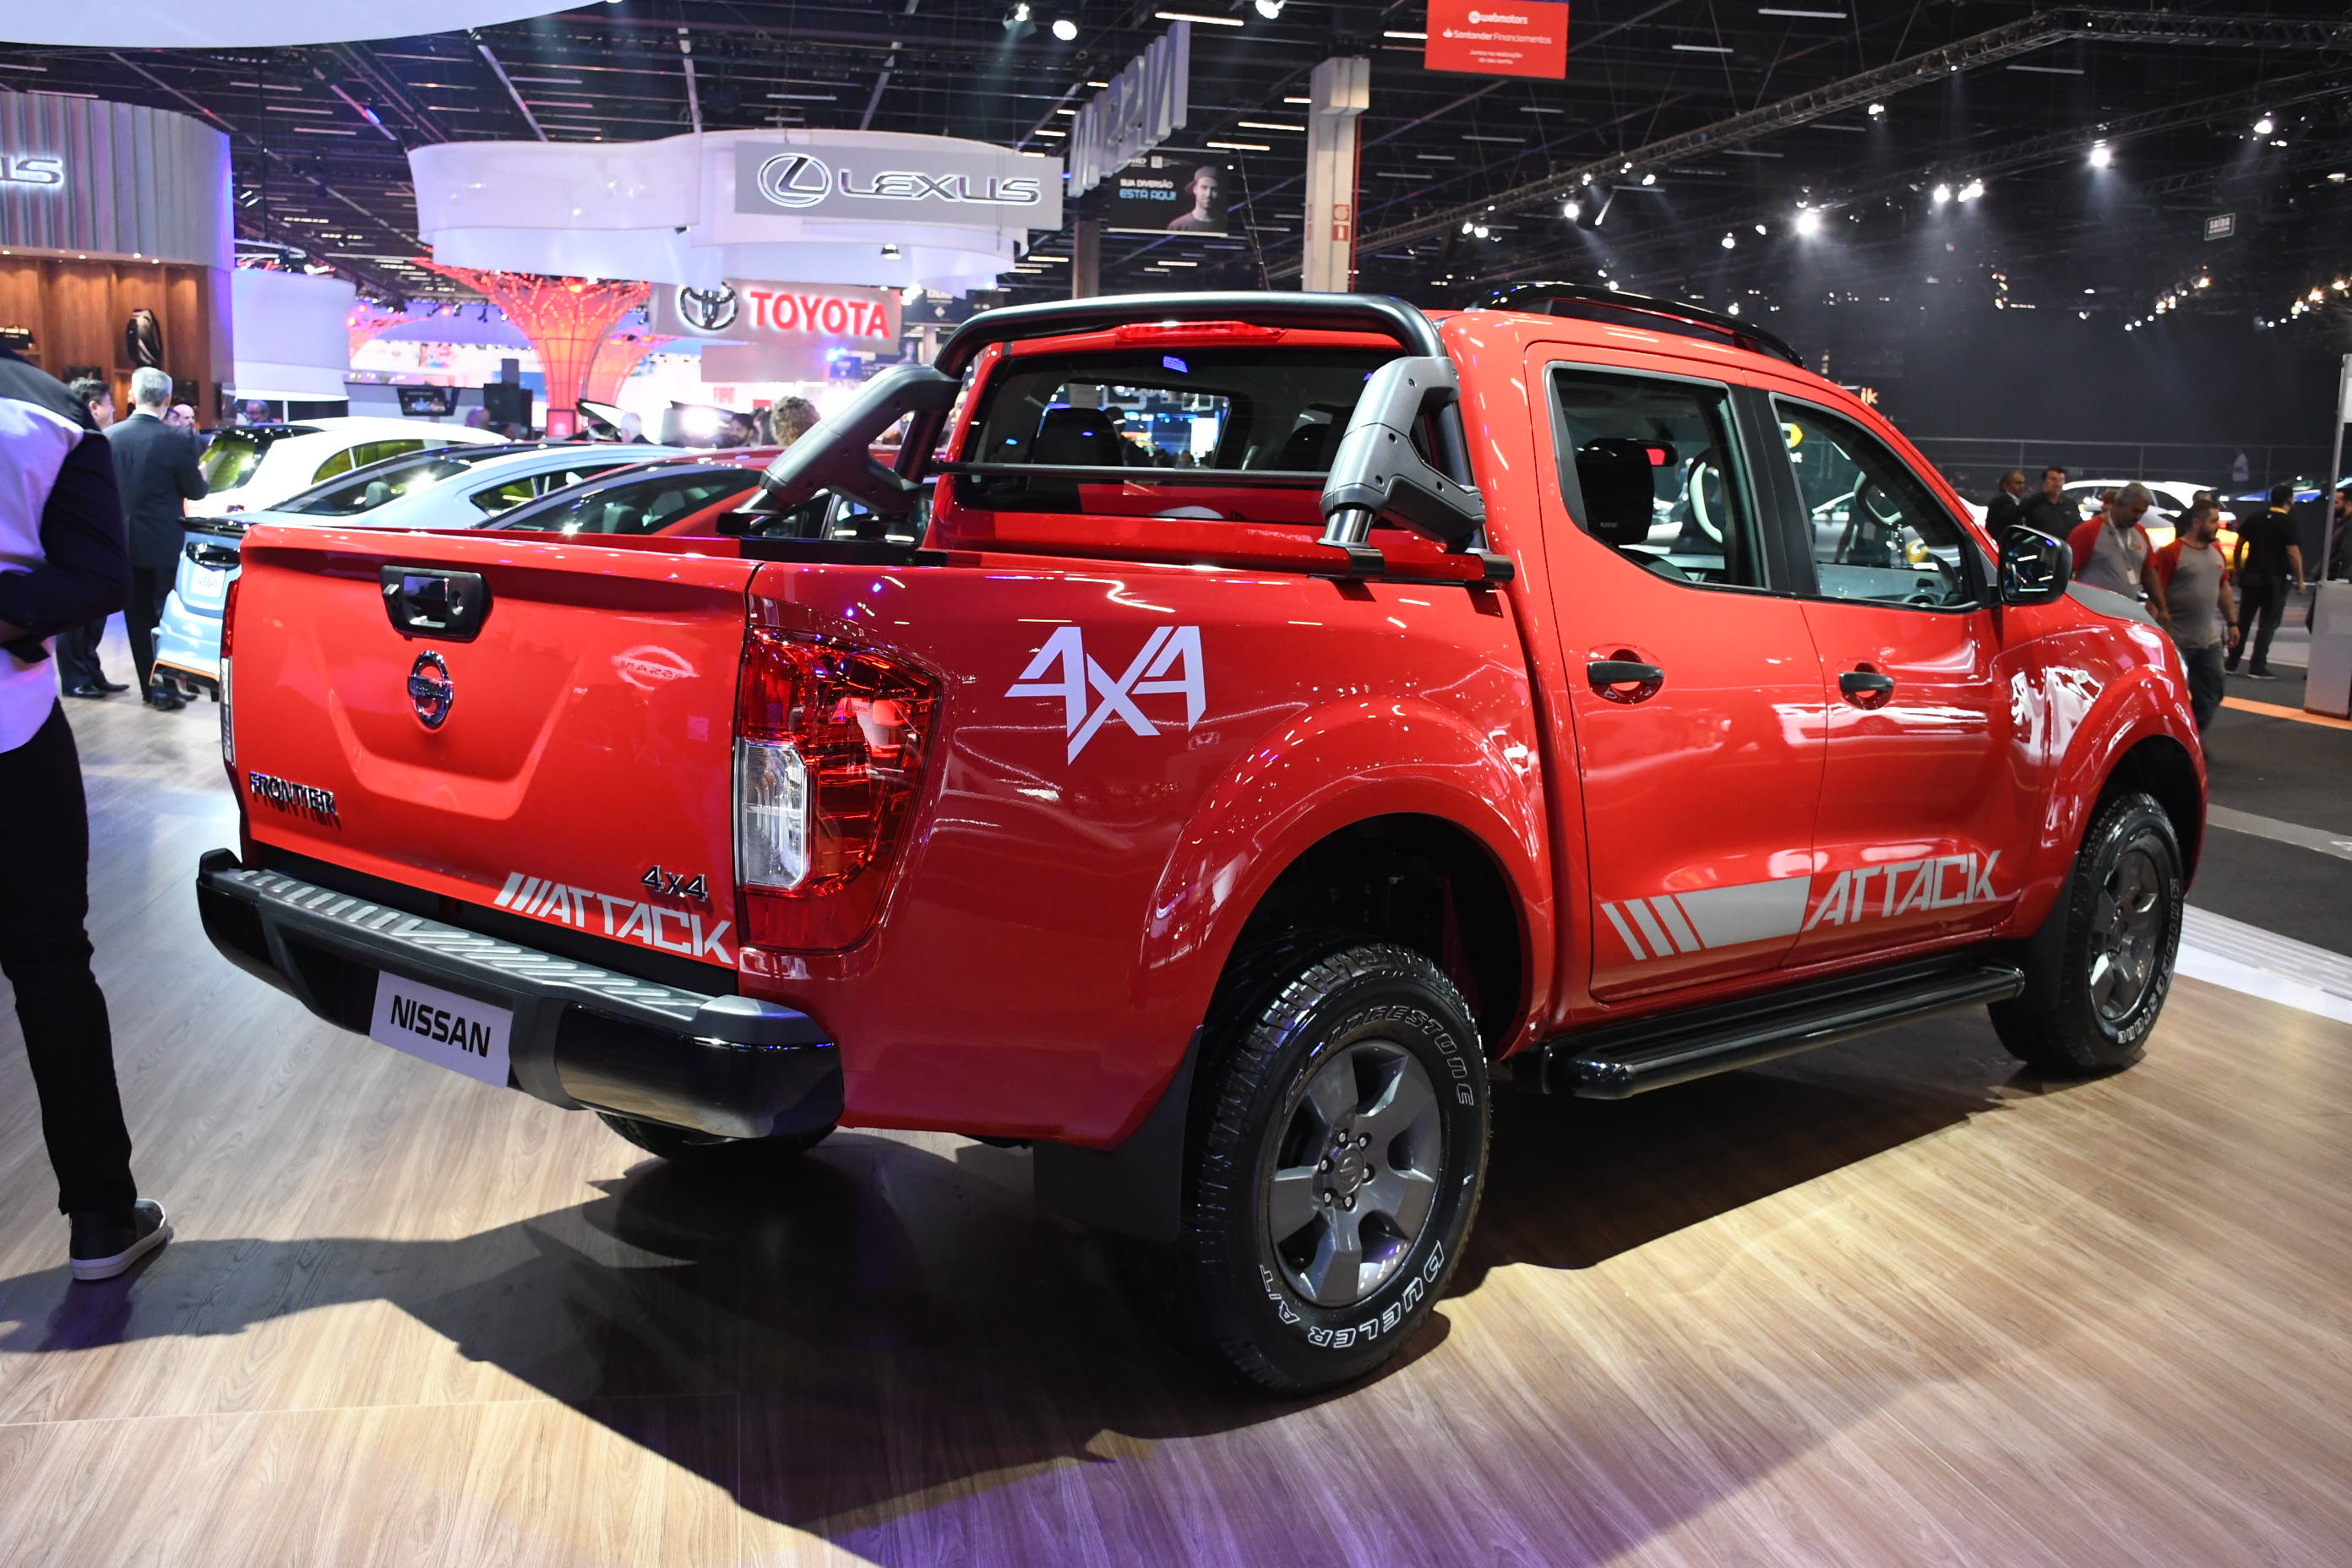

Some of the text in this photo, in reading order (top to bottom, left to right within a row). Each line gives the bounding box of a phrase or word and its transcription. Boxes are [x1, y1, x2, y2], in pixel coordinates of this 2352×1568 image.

[1453, 30, 1493, 41] Santander
[838, 168, 1042, 206] LEXUS
[749, 290, 891, 339] TOYOTA
[248, 770, 338, 815] FRONTIER
[1804, 850, 2001, 931] ATTACK
[537, 883, 734, 965] ATTACK
[390, 994, 492, 1059] NISSAN
[1308, 1239, 1445, 1349] DUELER
